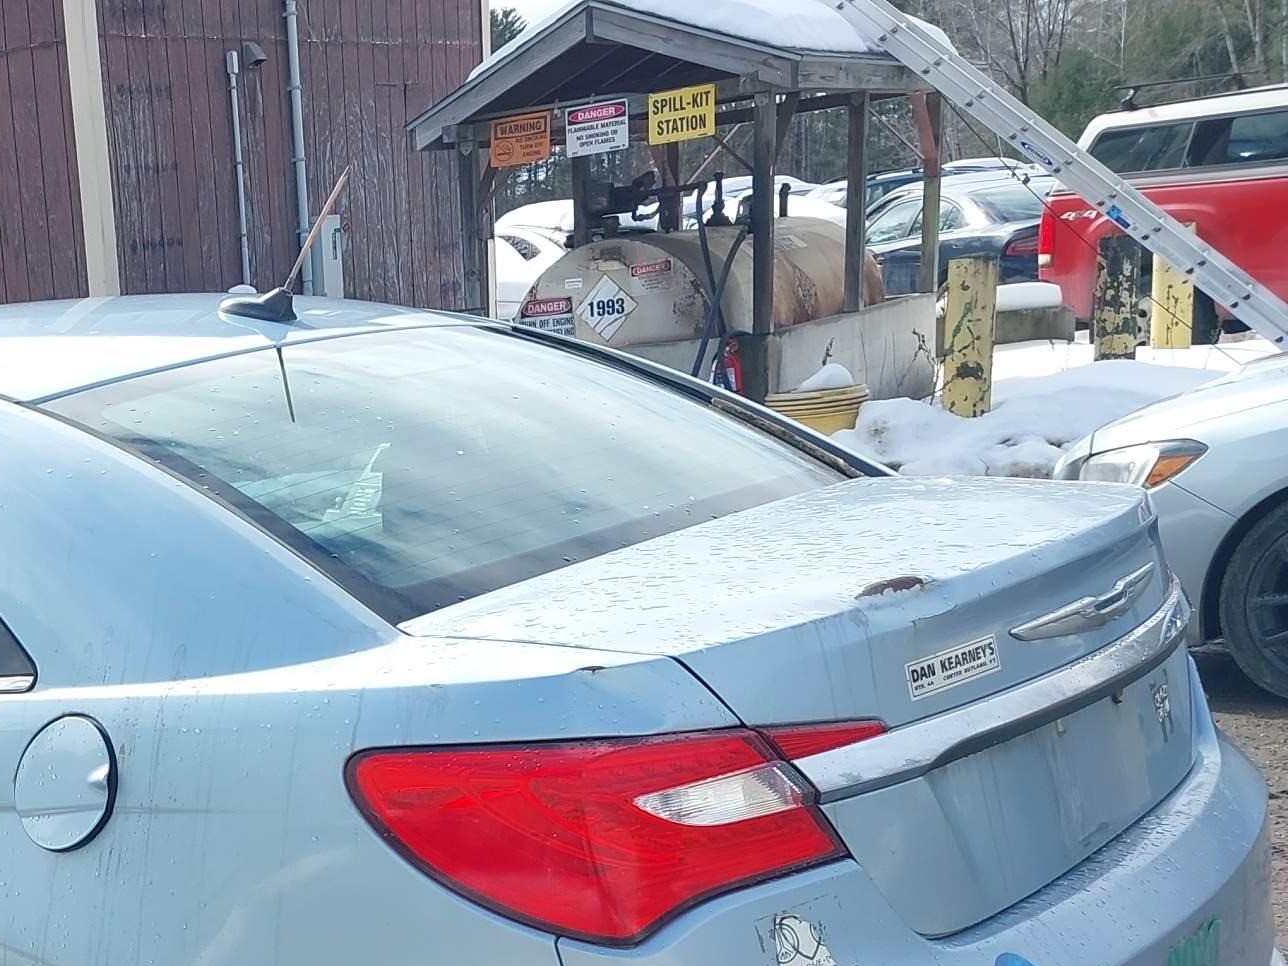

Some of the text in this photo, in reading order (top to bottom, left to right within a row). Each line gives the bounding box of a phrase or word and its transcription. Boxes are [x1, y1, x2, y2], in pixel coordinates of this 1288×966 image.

[653, 91, 710, 115] SPILL-KIT
[578, 107, 615, 120] DANGER
[499, 120, 542, 136] WARNING
[568, 119, 626, 134] FLAMMABLE MATERIAL
[657, 113, 706, 136] STATION
[585, 131, 609, 139] SMOKING
[595, 137, 616, 145] FLAMES
[528, 301, 566, 314] DANGER
[588, 297, 625, 317] 1993
[539, 319, 550, 328] OFF
[553, 317, 574, 327] ENGINE
[911, 642, 995, 683] DAN KEARNEY'S
